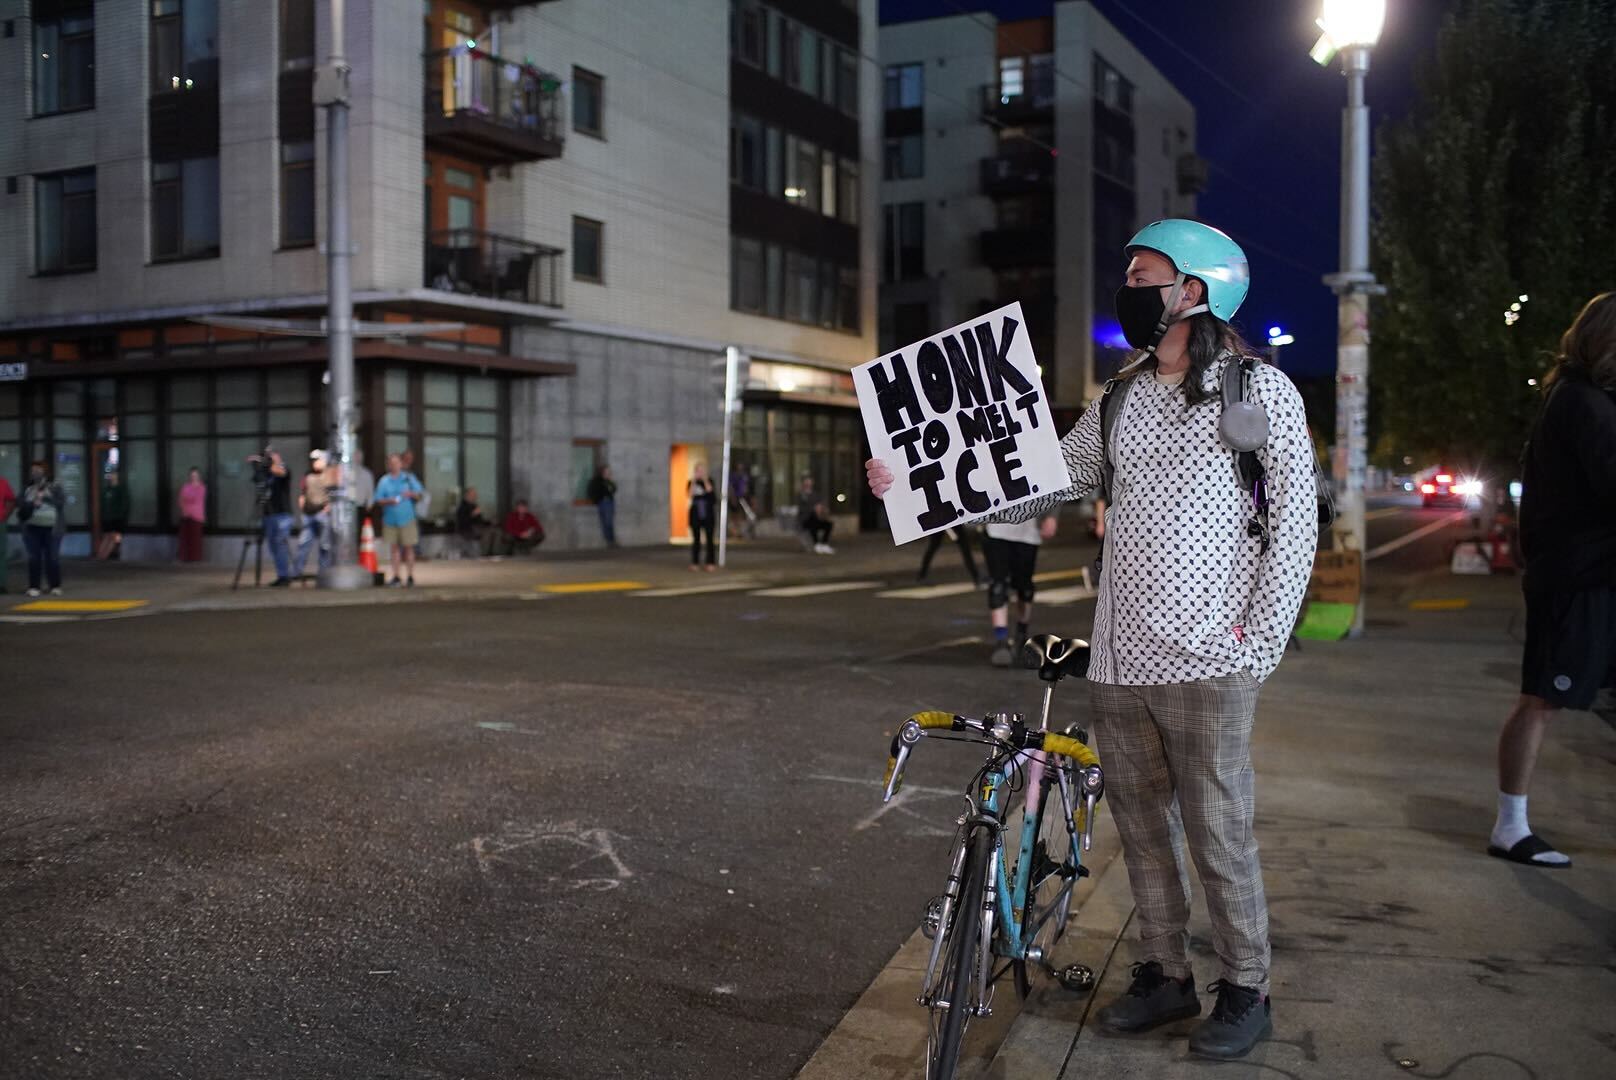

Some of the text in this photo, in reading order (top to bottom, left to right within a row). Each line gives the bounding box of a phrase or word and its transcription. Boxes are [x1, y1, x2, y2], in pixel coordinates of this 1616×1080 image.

[868, 316, 1034, 435] HONK
[891, 391, 1039, 468] TO MELT
[909, 435, 1039, 531] I.C.E.
